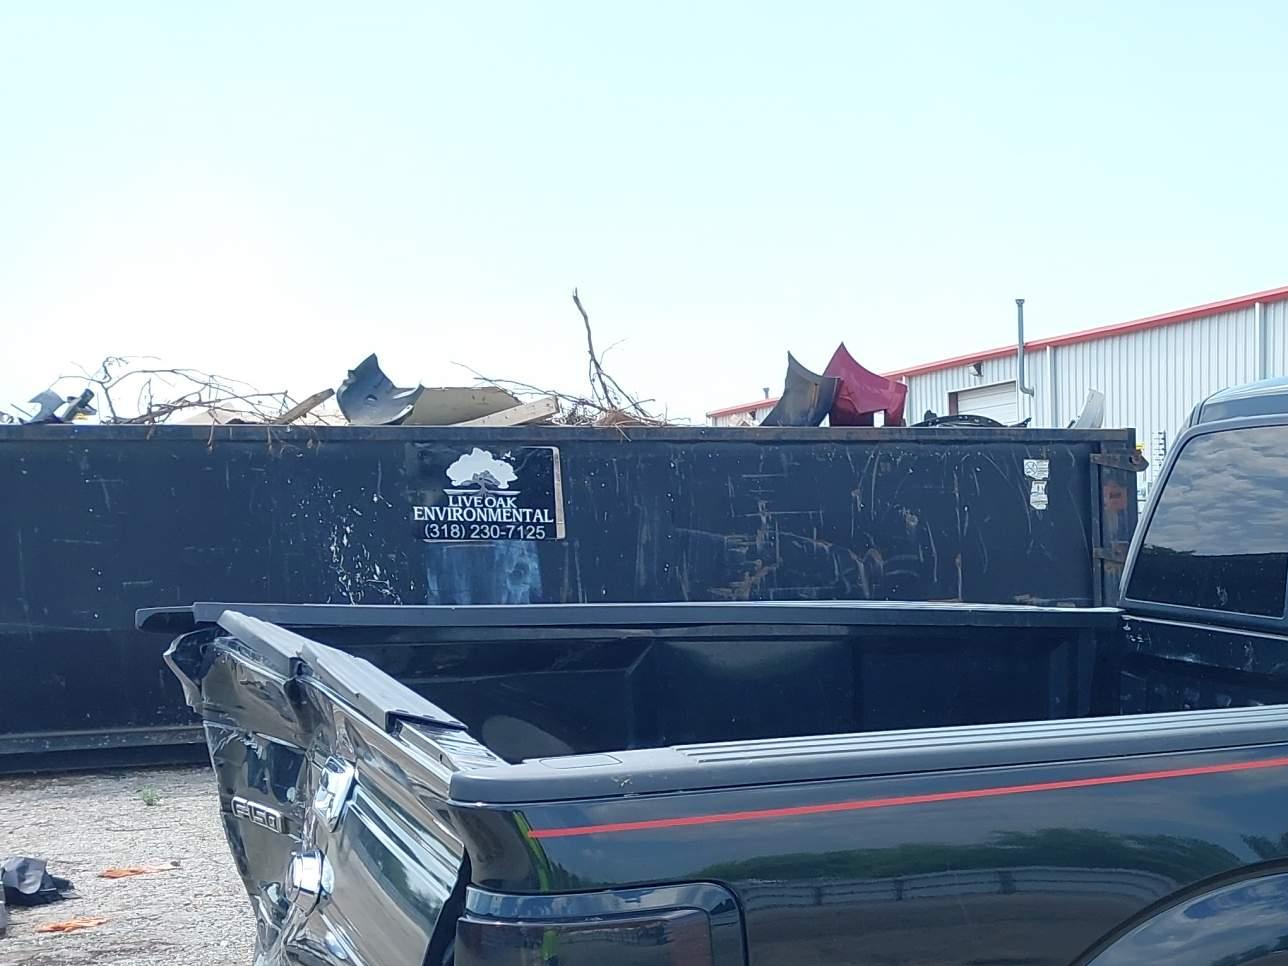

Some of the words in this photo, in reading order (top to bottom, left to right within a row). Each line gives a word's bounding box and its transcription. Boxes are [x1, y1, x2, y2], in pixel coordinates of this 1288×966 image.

[448, 496, 484, 508] LIVE
[484, 497, 518, 509] OAK
[413, 506, 554, 523] ENVIRONMENTAL
[424, 523, 466, 539] (318)
[470, 524, 546, 540] 230-7125
